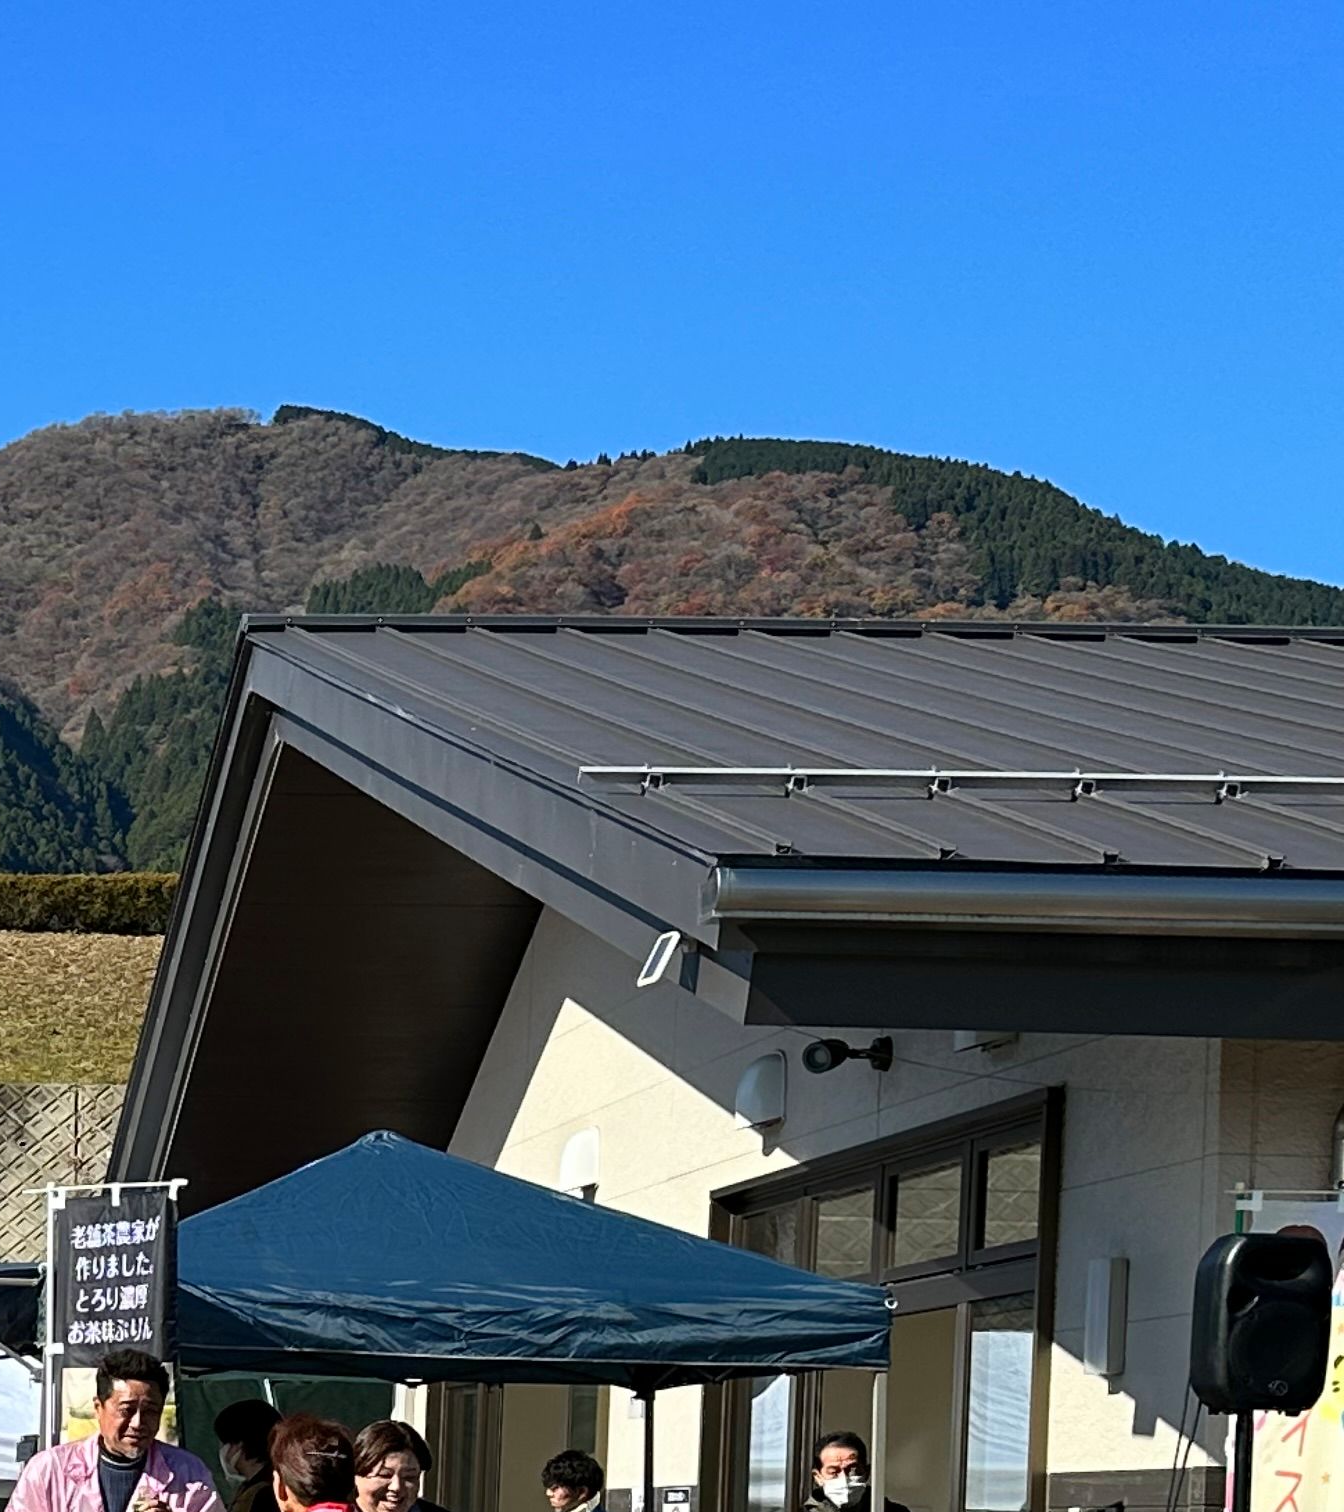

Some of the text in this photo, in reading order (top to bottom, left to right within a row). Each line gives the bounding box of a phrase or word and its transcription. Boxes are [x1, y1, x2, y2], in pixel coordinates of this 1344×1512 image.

[71, 1215, 160, 1249] 老舗茶農家が
[75, 1284, 149, 1312] とろり濃厚
